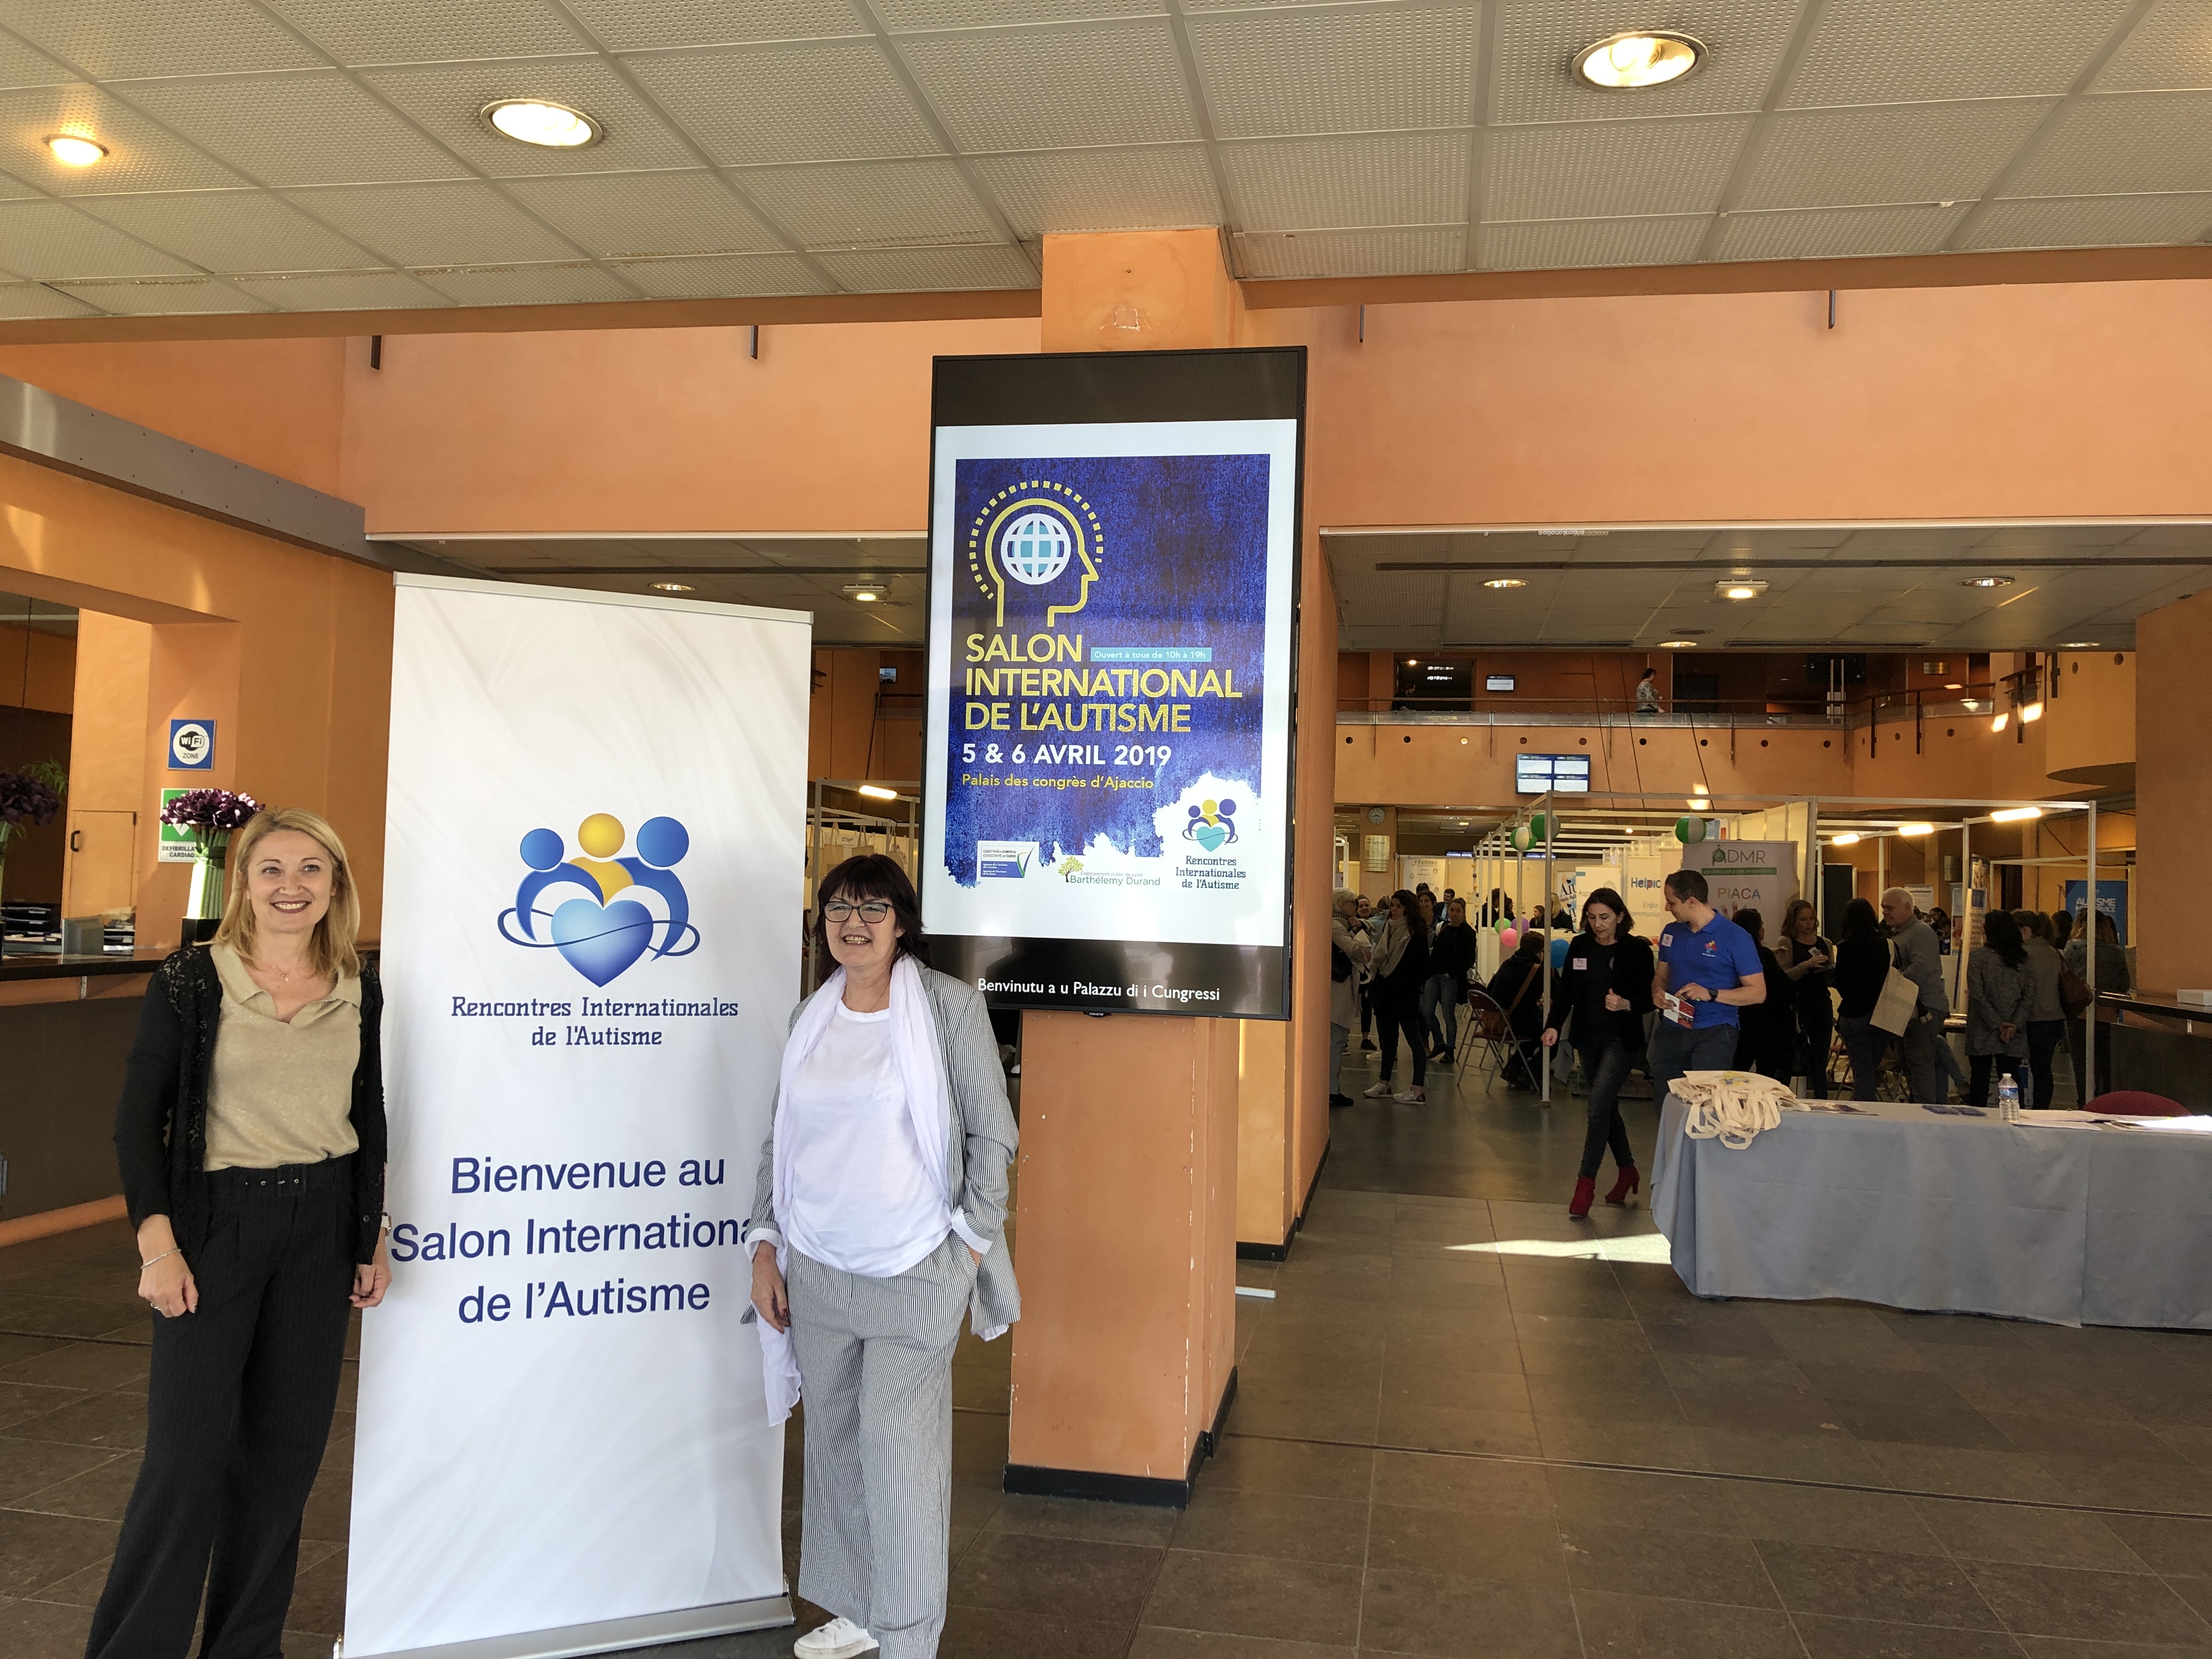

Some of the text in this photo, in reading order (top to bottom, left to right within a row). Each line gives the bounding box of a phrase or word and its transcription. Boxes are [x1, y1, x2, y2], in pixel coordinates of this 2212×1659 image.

[966, 634, 1082, 663] SALON
[966, 668, 1243, 698] INTERNATIONAL
[965, 703, 1191, 732] DE L'AUTISME
[962, 743, 1172, 766] 5 & 6 AVRIL 2019
[962, 774, 1154, 791] Palais des congrès d'Ajaccio
[1186, 855, 1237, 866] Rencontres
[1712, 846, 1765, 866] ADMR
[1070, 876, 1160, 885] Barthélemy Durand
[1176, 867, 1246, 878] Internationales
[1182, 879, 1239, 889] de l'Autisme
[1718, 888, 1761, 900] PIACA
[2076, 898, 2115, 906] AUSME
[977, 978, 1220, 1003] Benvinutu a u Palazzu di i Cungressi
[451, 997, 738, 1017] Rencontres Internationales
[532, 1026, 663, 1046] de l'Autisme
[452, 1157, 725, 1194] Bienvenue au
[391, 1223, 511, 1263] Salon
[458, 1278, 710, 1324] de l'Autisme
